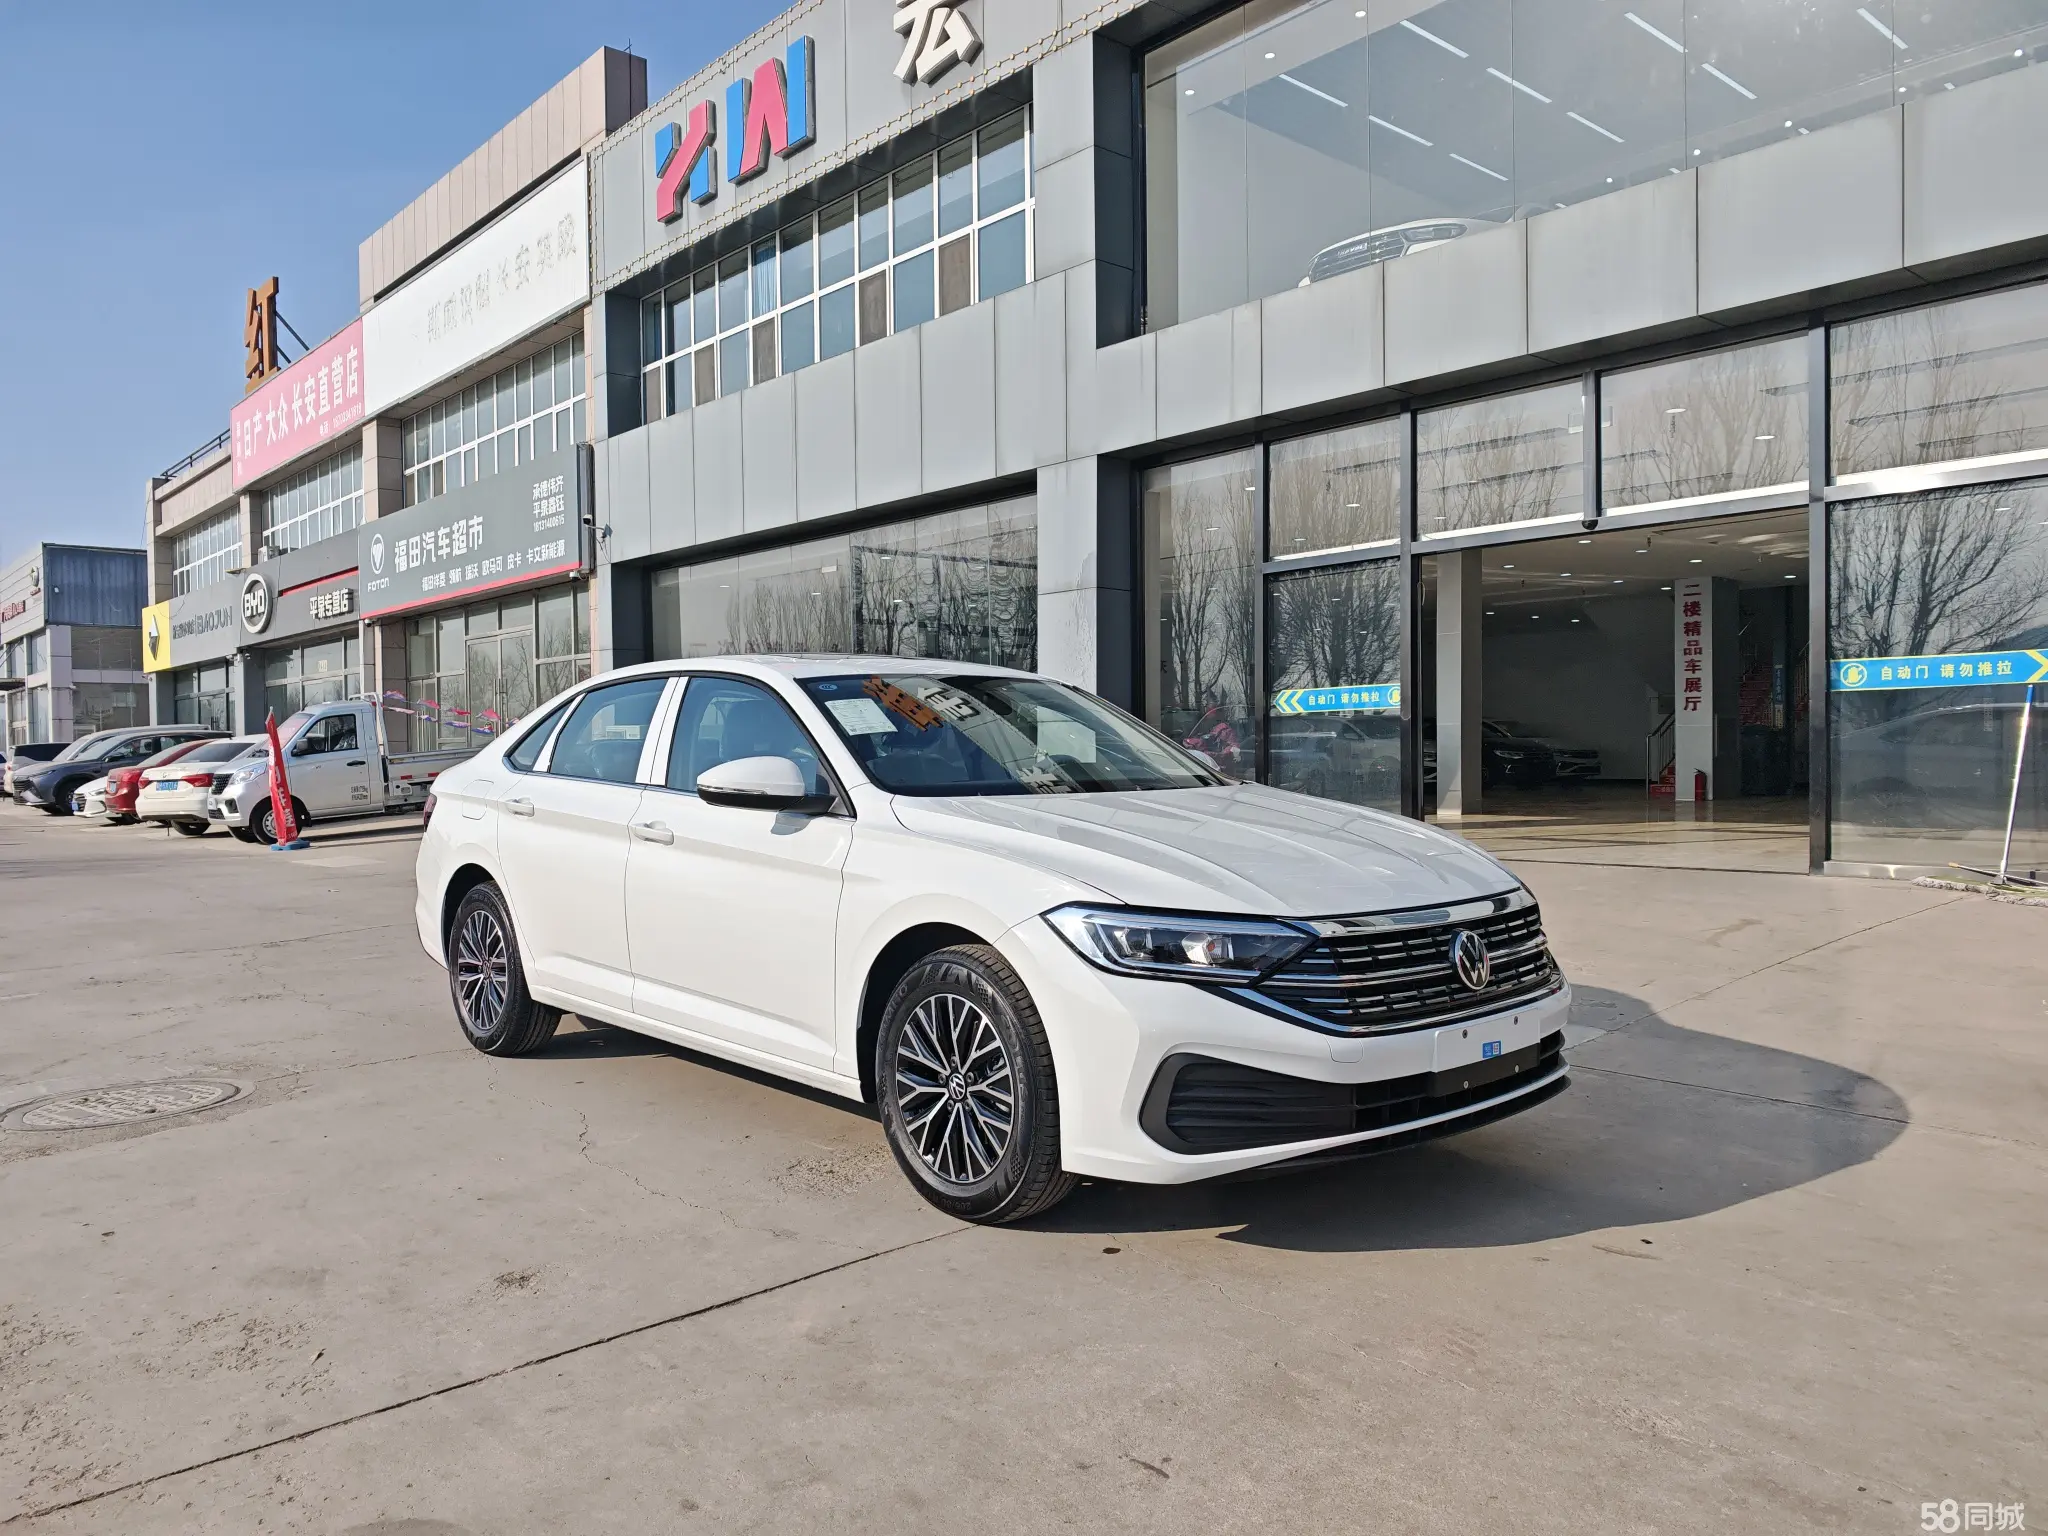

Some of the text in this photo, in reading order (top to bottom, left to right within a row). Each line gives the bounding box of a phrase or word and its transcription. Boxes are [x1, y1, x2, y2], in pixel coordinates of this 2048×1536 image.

[243, 408, 262, 459] 日产
[265, 392, 289, 447] 大众
[291, 343, 358, 432] 长安直营店
[394, 515, 484, 574] 福田汽车超市
[244, 588, 266, 618] BYD
[1683, 583, 1702, 712] 二楼精品车展厅
[1881, 660, 2013, 681] 自动门 请勿推拉
[1308, 691, 1380, 706] 自动门 请勿推拉
